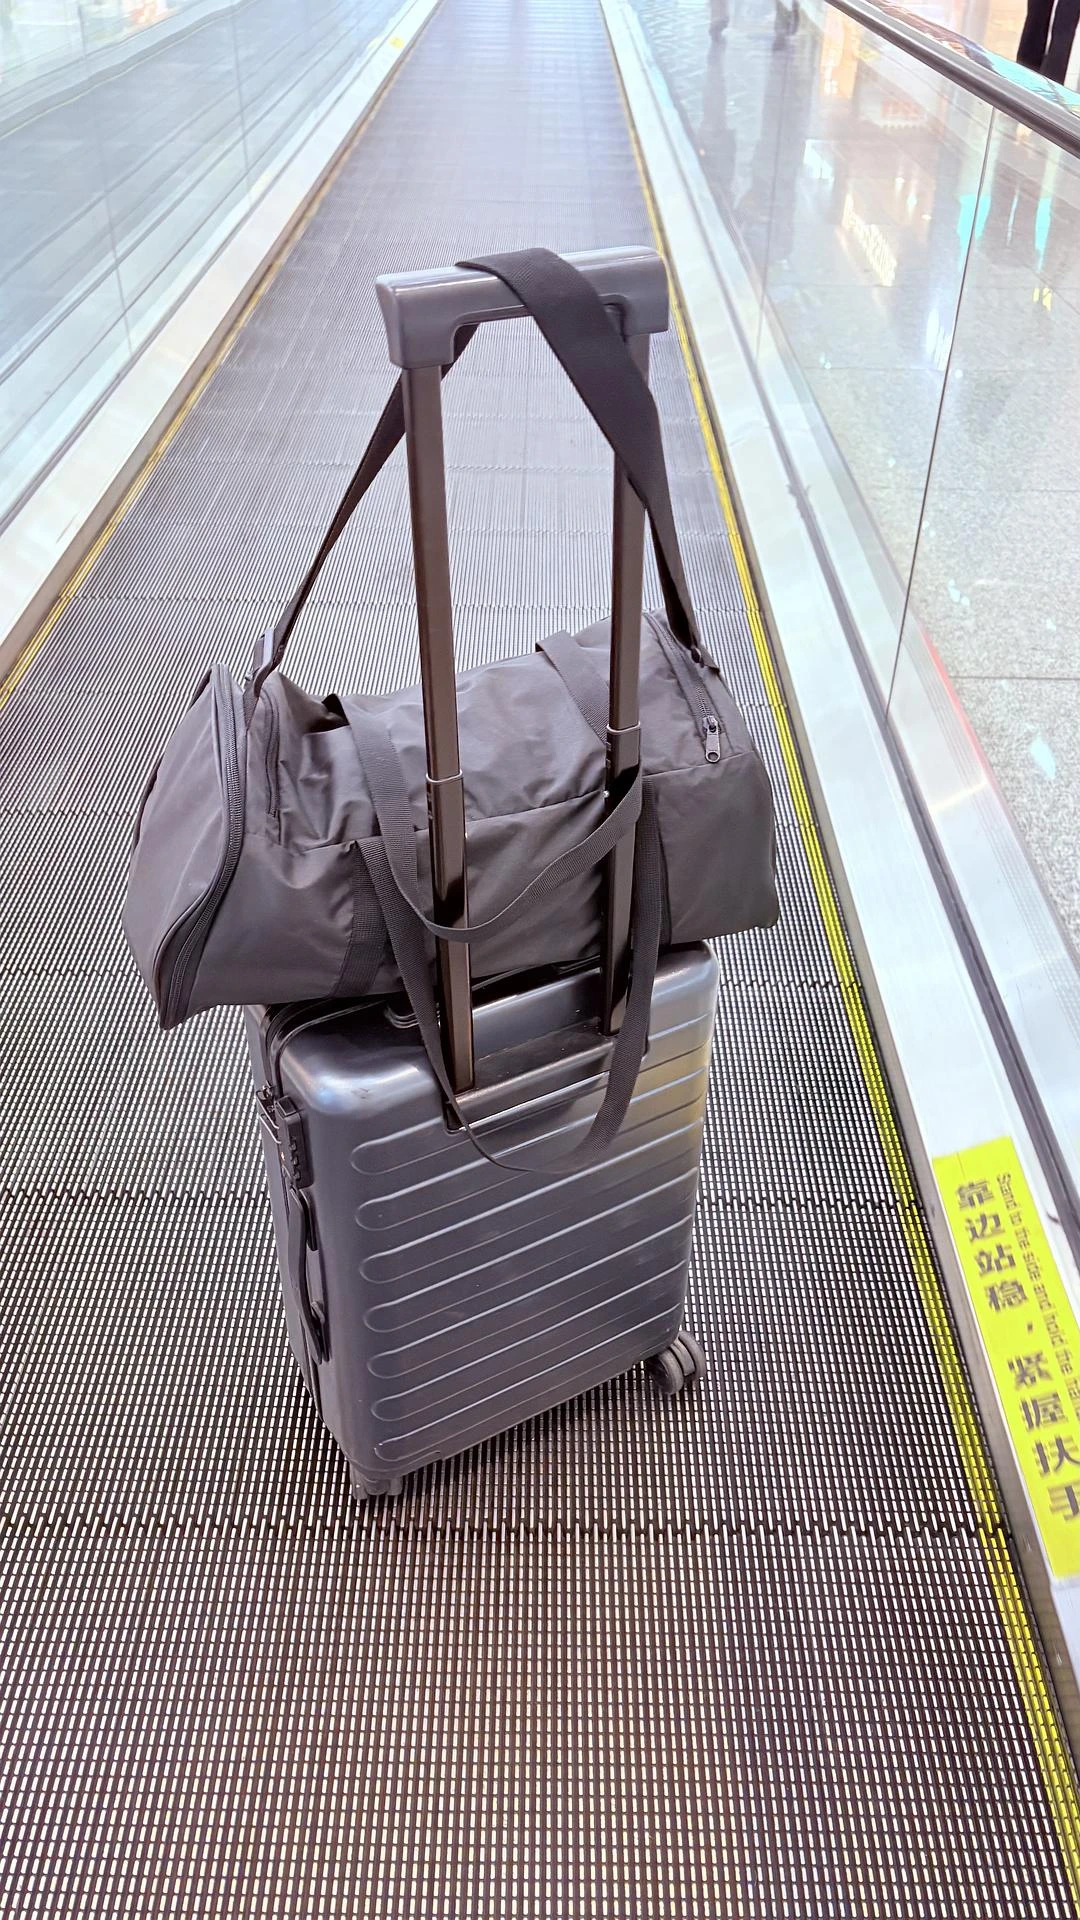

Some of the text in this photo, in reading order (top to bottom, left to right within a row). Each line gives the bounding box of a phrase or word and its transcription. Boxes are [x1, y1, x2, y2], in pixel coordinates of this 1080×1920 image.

[997, 1173, 1020, 1210] Stand
[1009, 1211, 1023, 1227] to
[1015, 1226, 1031, 1251] the
[1022, 1250, 1042, 1282] side
[1033, 1282, 1055, 1311] and
[1043, 1310, 1069, 1347] hold
[1055, 1347, 1074, 1376] the
